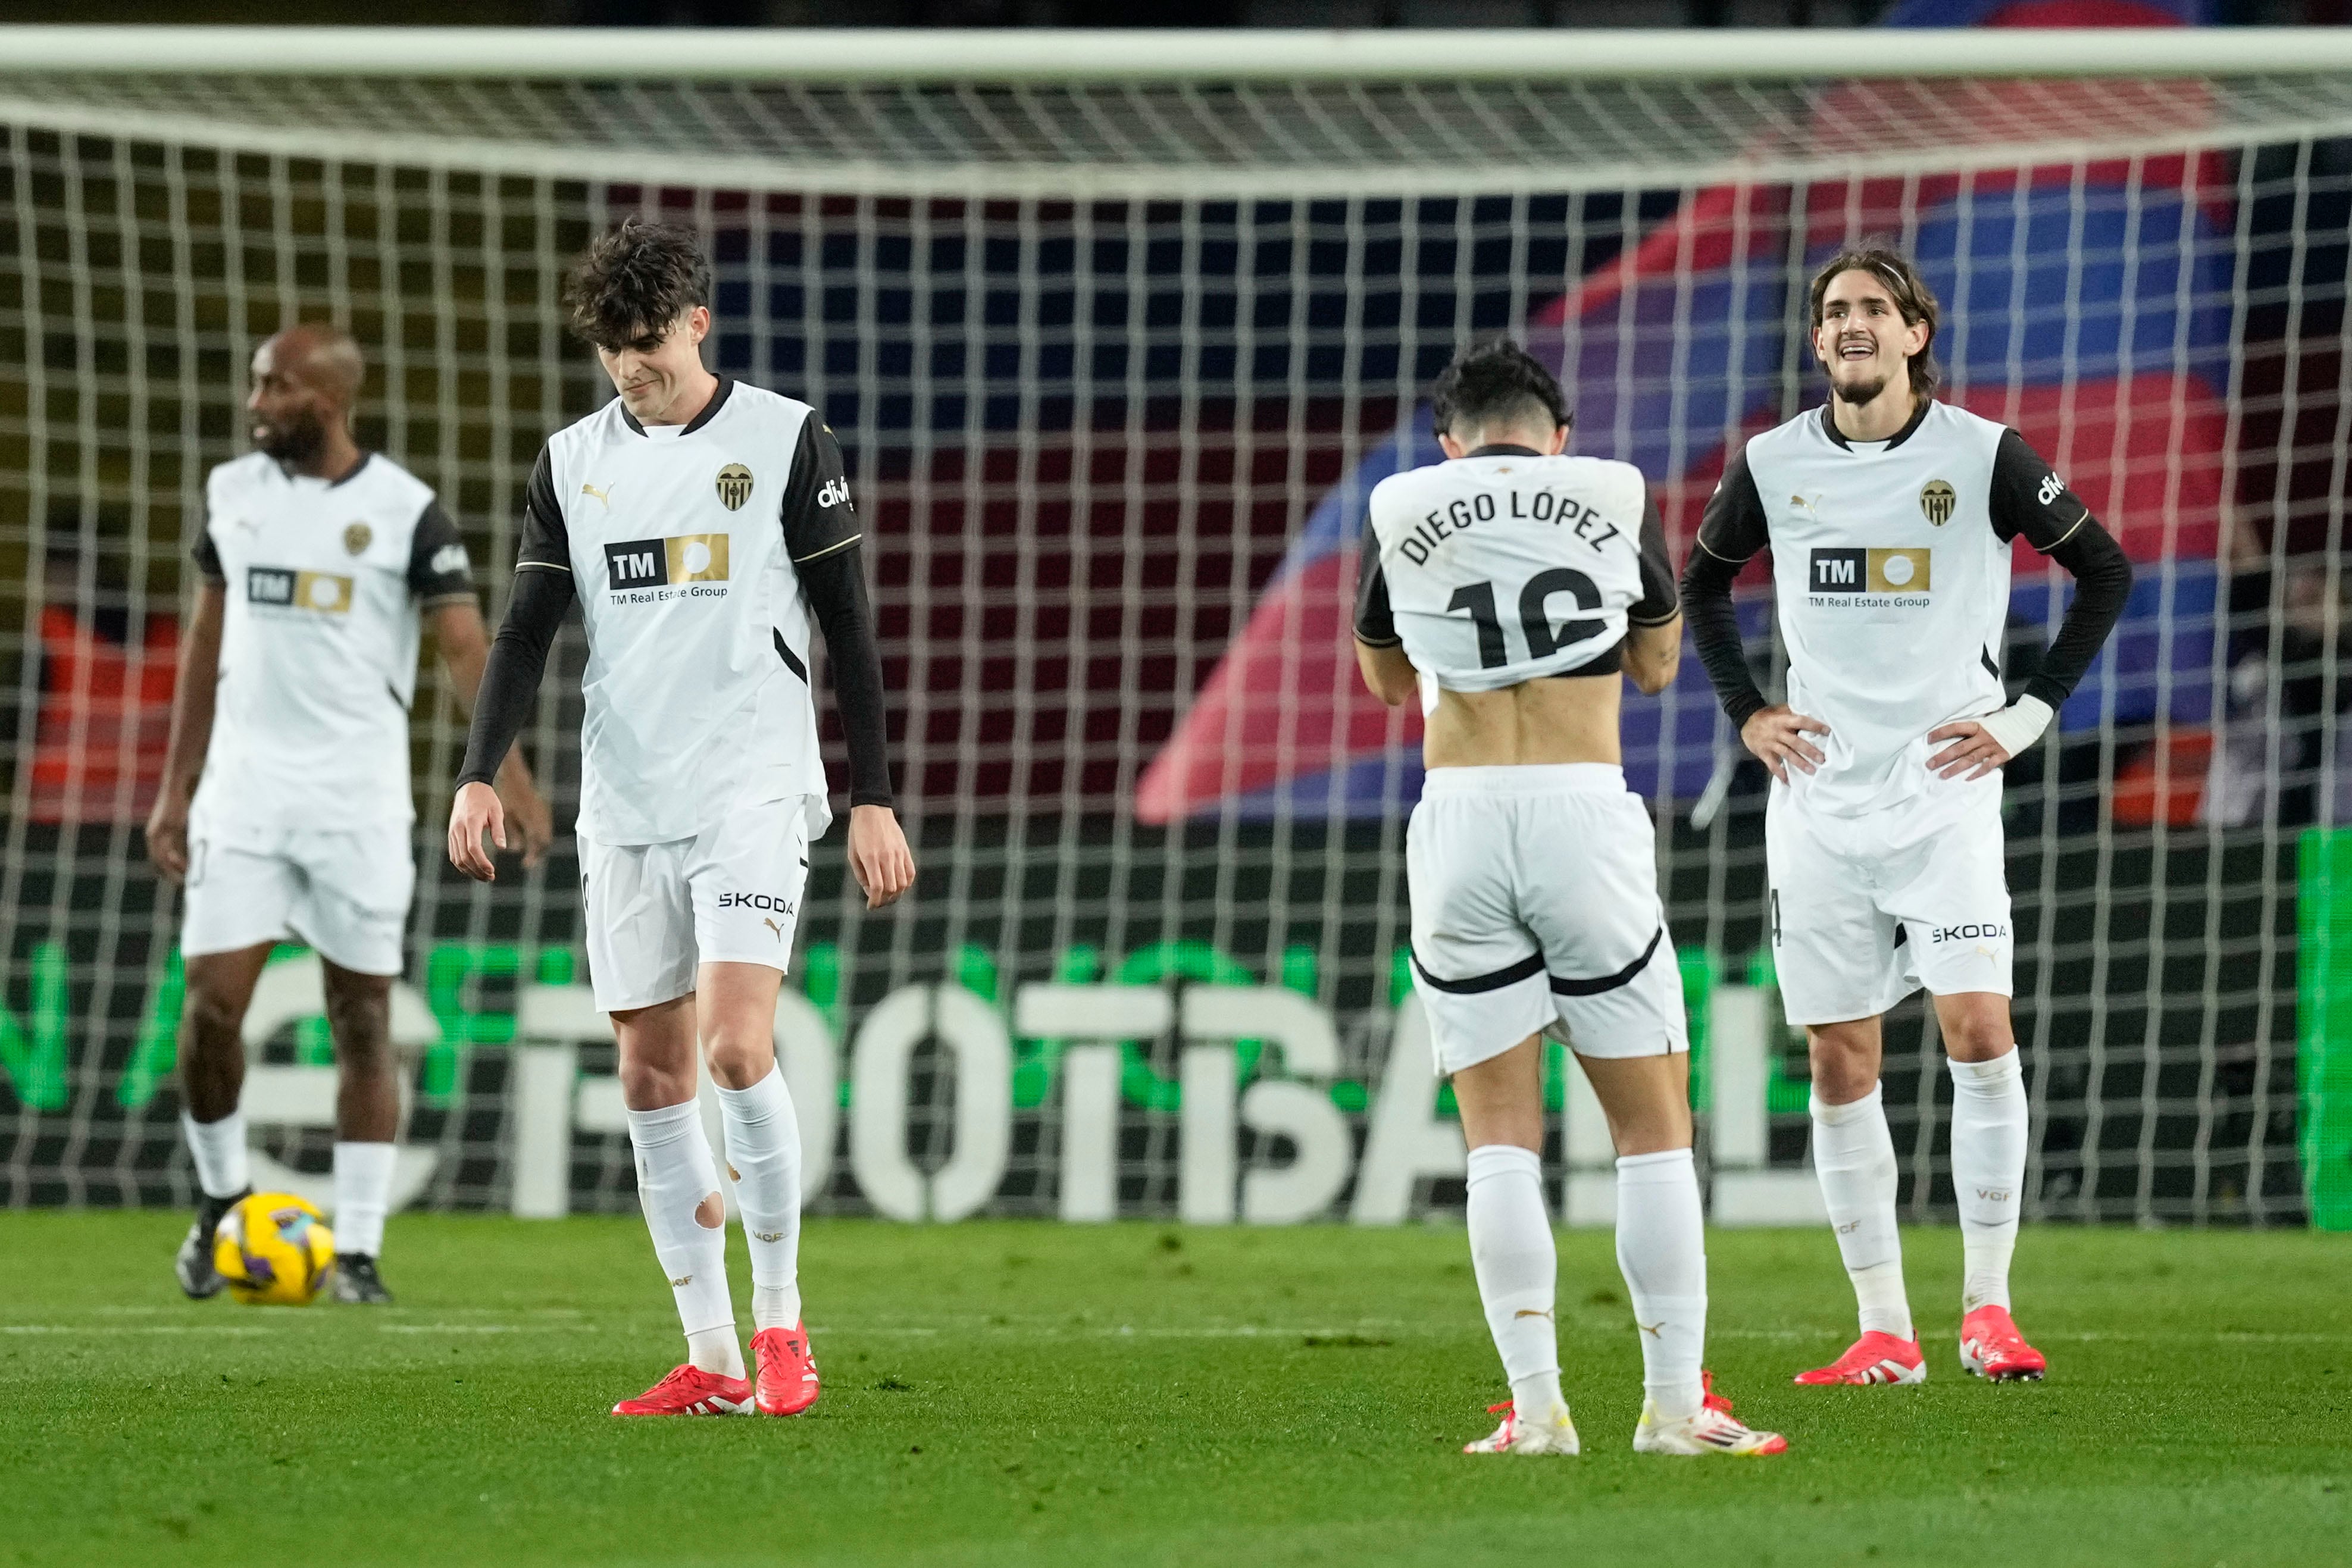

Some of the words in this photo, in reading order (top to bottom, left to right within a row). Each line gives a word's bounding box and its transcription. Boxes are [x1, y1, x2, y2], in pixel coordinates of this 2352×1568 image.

[1400, 493, 1496, 566] DIEGO
[1511, 486, 1619, 553] LÓPEZ
[612, 552, 655, 580] TM
[1816, 559, 1854, 584] TM
[611, 595, 627, 605] TM
[631, 591, 654, 603] Real
[659, 589, 687, 601] Estate
[691, 587, 728, 599] Group
[1809, 597, 1824, 607] TM
[1828, 597, 1851, 607] Real
[1854, 597, 1890, 607] Estate
[1894, 597, 1930, 608] Group
